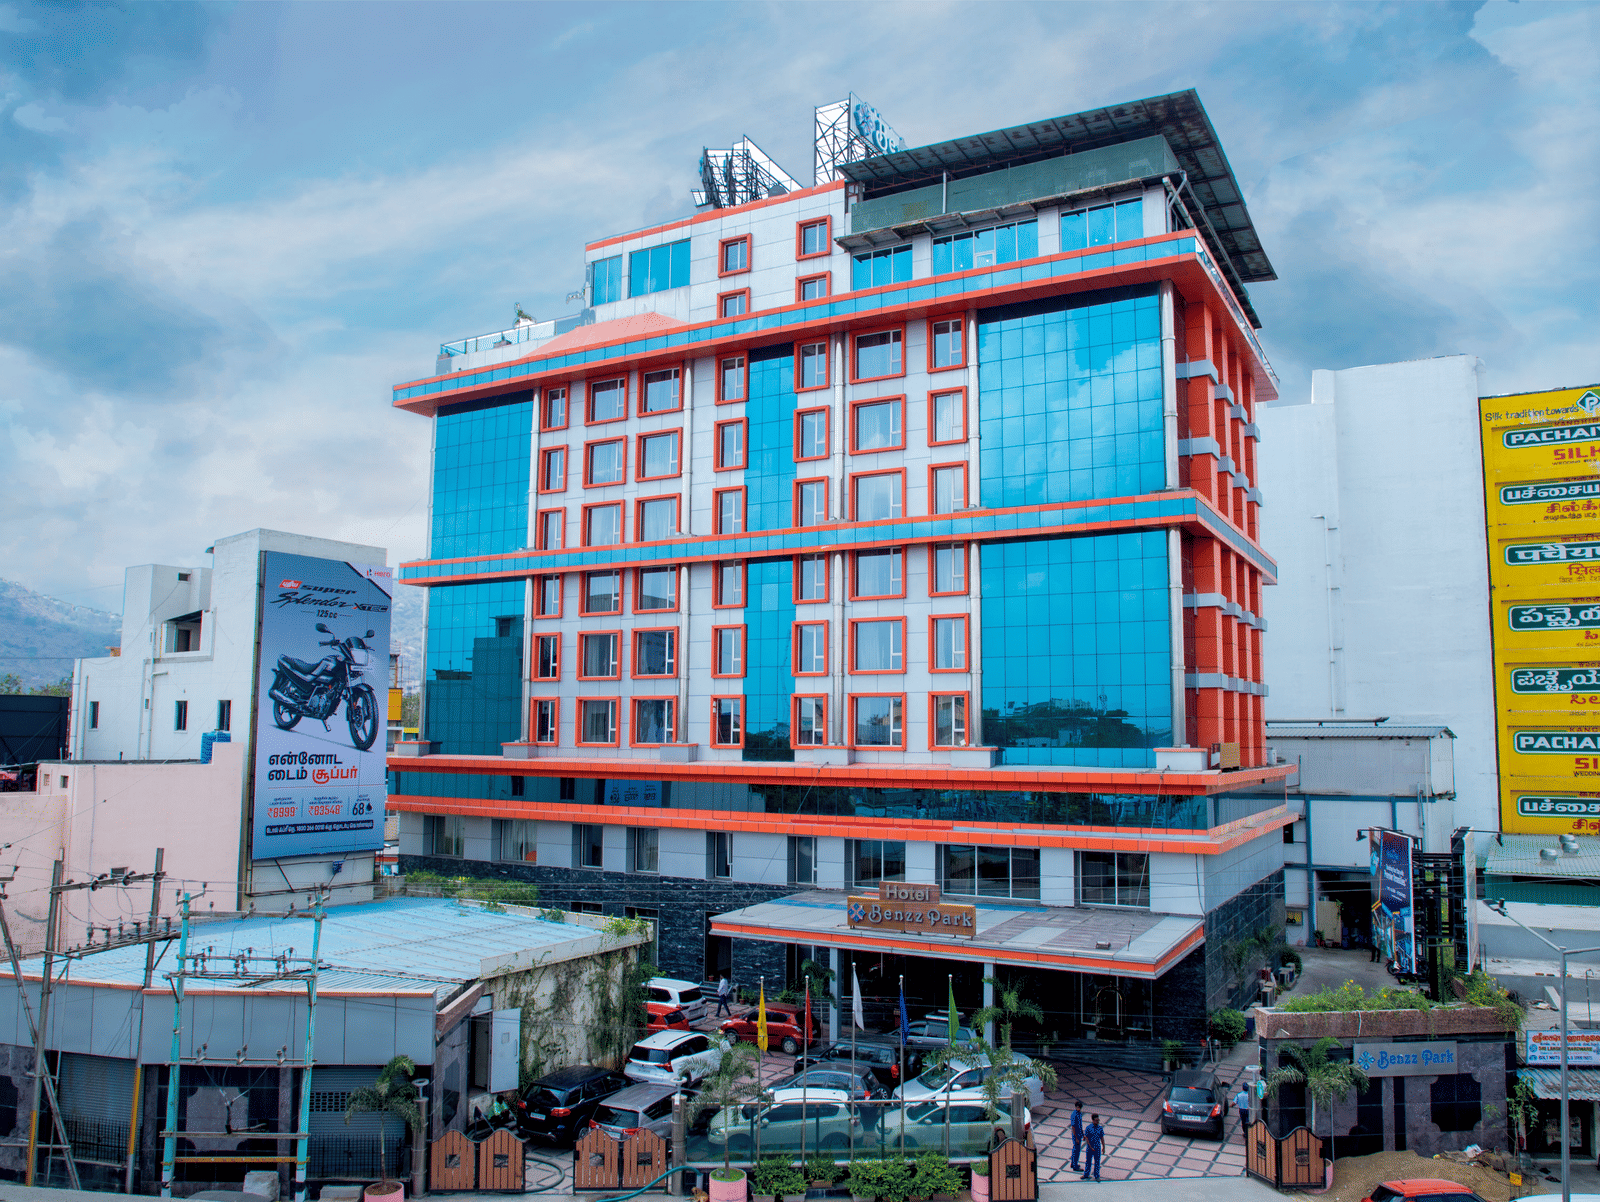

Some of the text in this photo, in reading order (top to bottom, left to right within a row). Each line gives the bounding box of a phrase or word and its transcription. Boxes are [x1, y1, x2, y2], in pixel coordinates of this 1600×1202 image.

[1485, 411, 1502, 422] Silk
[1505, 408, 1545, 419] tradition
[270, 591, 354, 609] Splendor
[316, 609, 338, 619] 125cc
[268, 751, 344, 766] என்னோட
[267, 765, 359, 785] டைம் சூப்பர்
[352, 802, 366, 816] 68
[885, 885, 930, 901] Hotel
[868, 904, 974, 927] Benzz Park
[1377, 1048, 1455, 1070] Benzz Park
